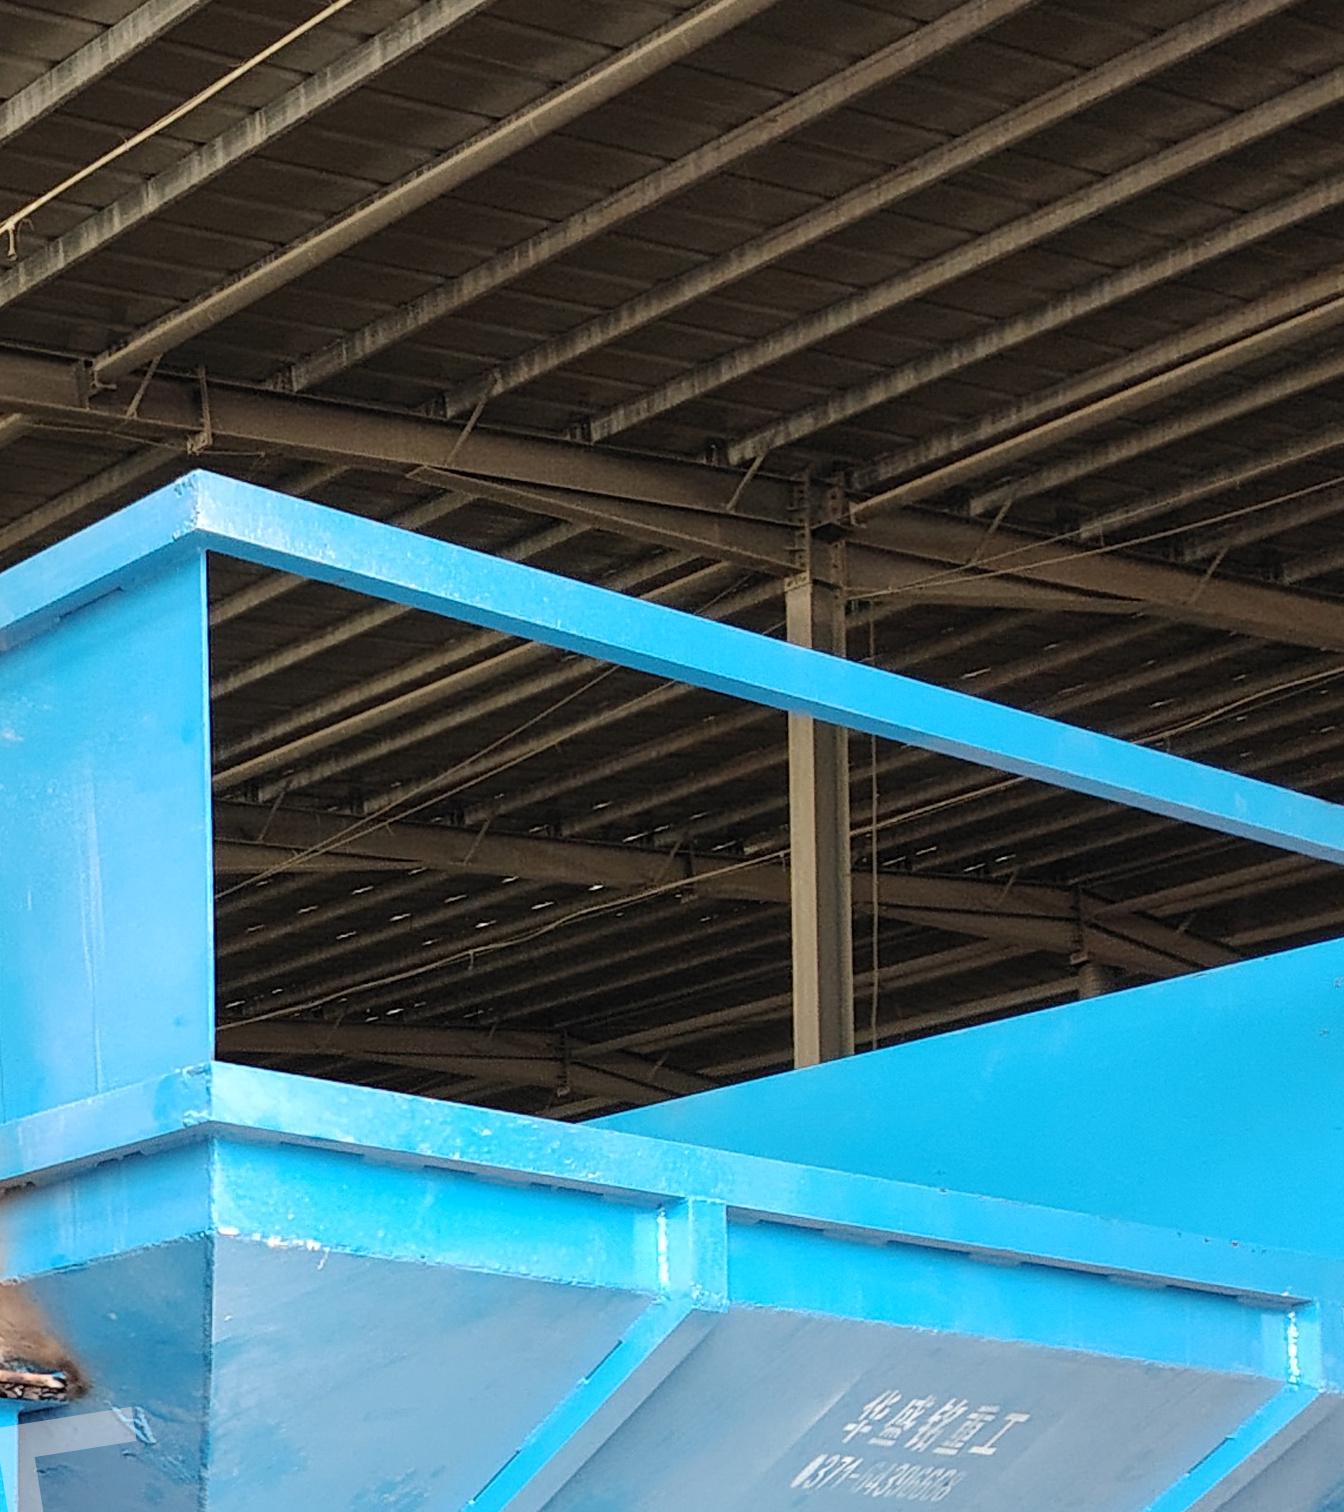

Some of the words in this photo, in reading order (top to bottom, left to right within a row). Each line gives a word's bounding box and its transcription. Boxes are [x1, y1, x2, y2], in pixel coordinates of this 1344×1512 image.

[842, 1389, 1031, 1455] 华盛铭重工
